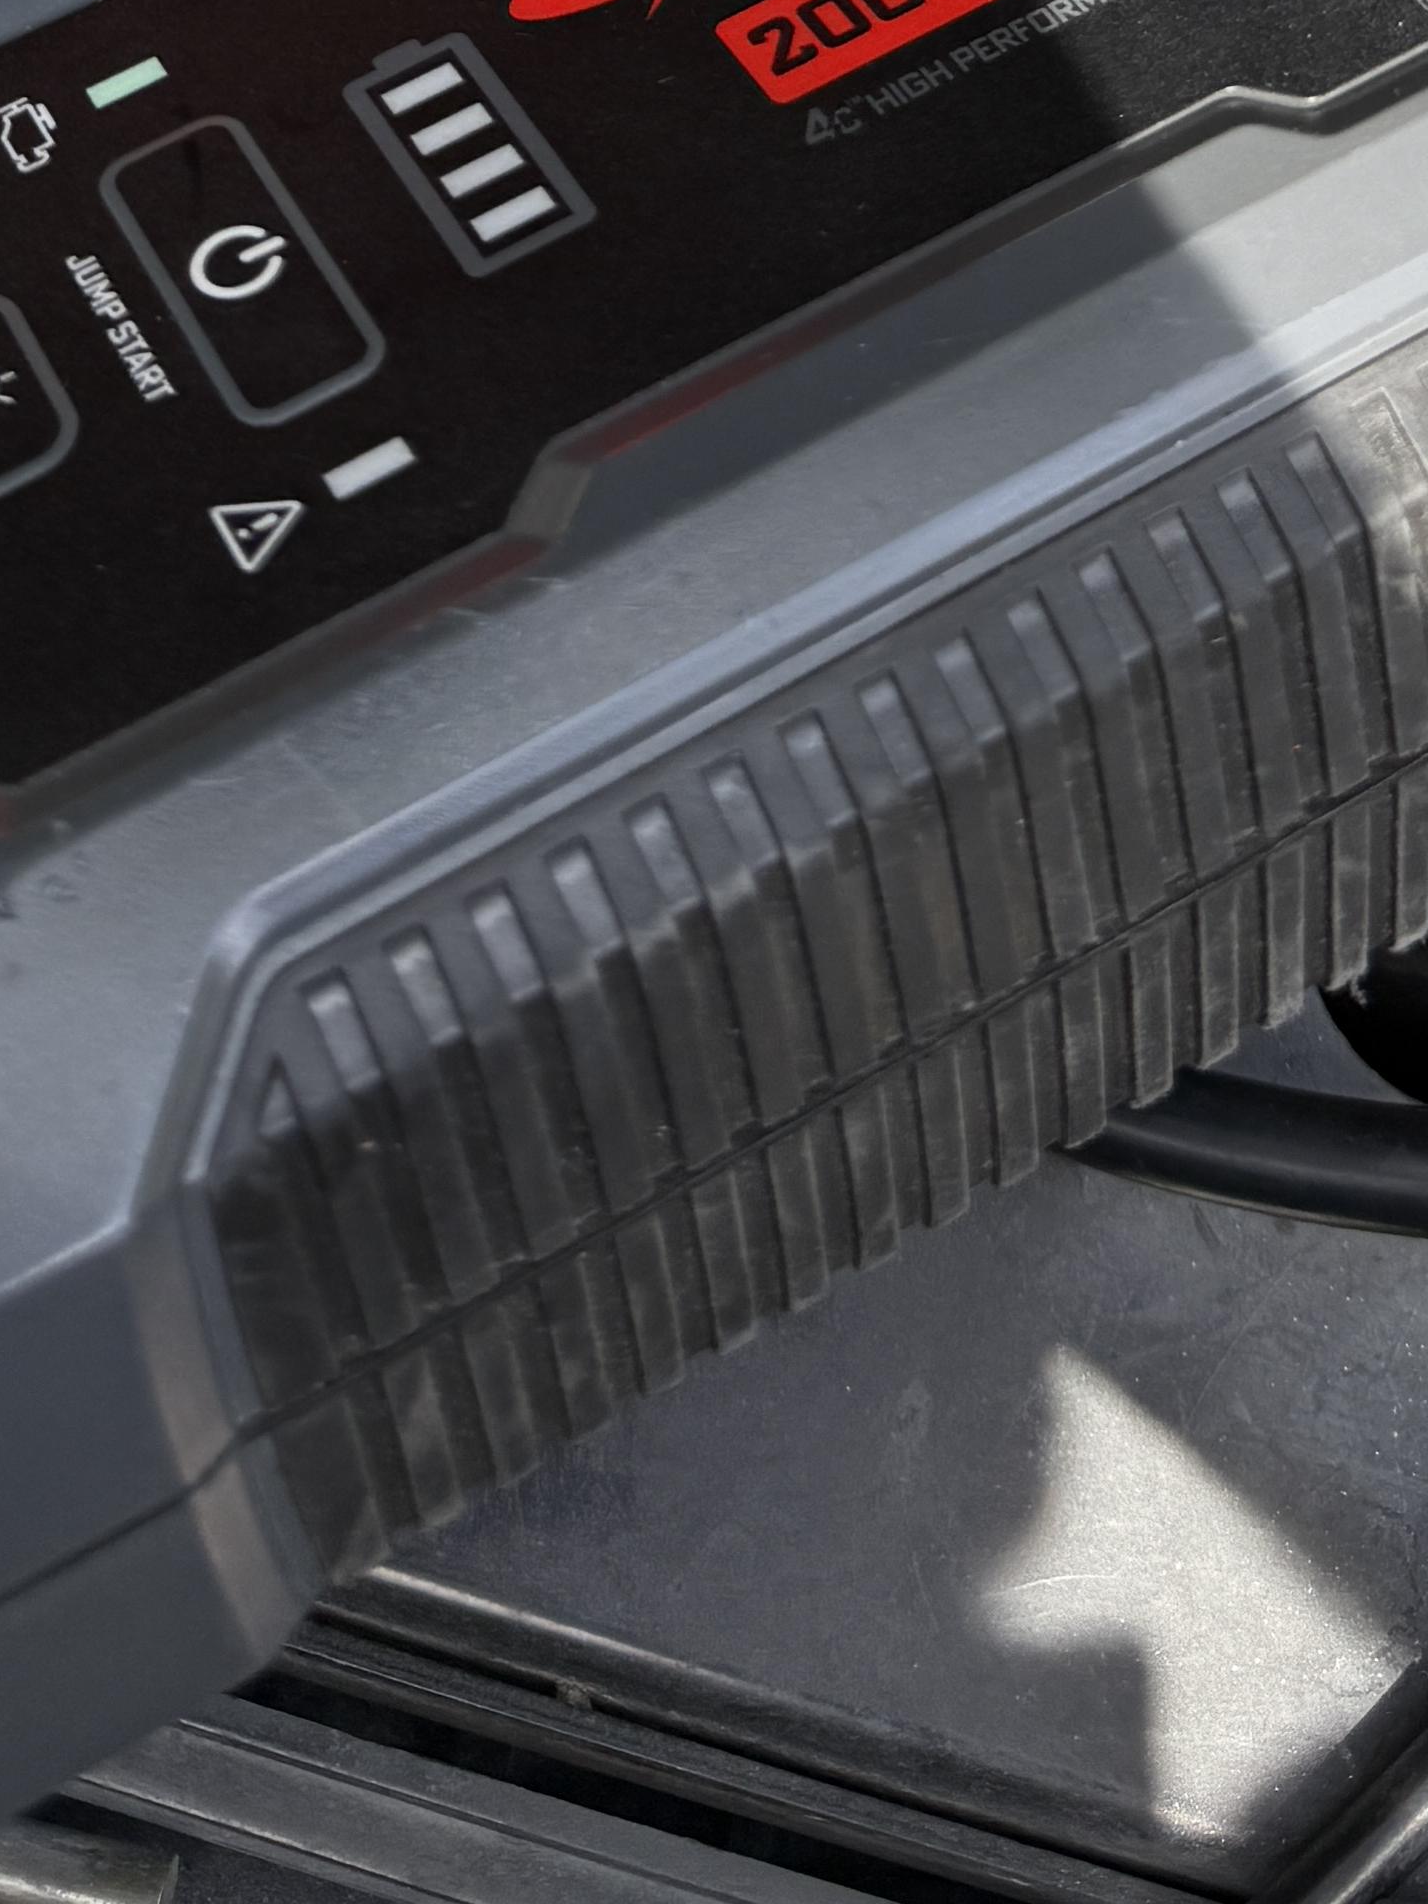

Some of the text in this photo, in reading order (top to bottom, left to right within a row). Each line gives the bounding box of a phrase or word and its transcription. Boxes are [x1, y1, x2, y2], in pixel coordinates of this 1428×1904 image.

[866, 58, 953, 115] HIGH
[65, 254, 180, 403] JUMP START
